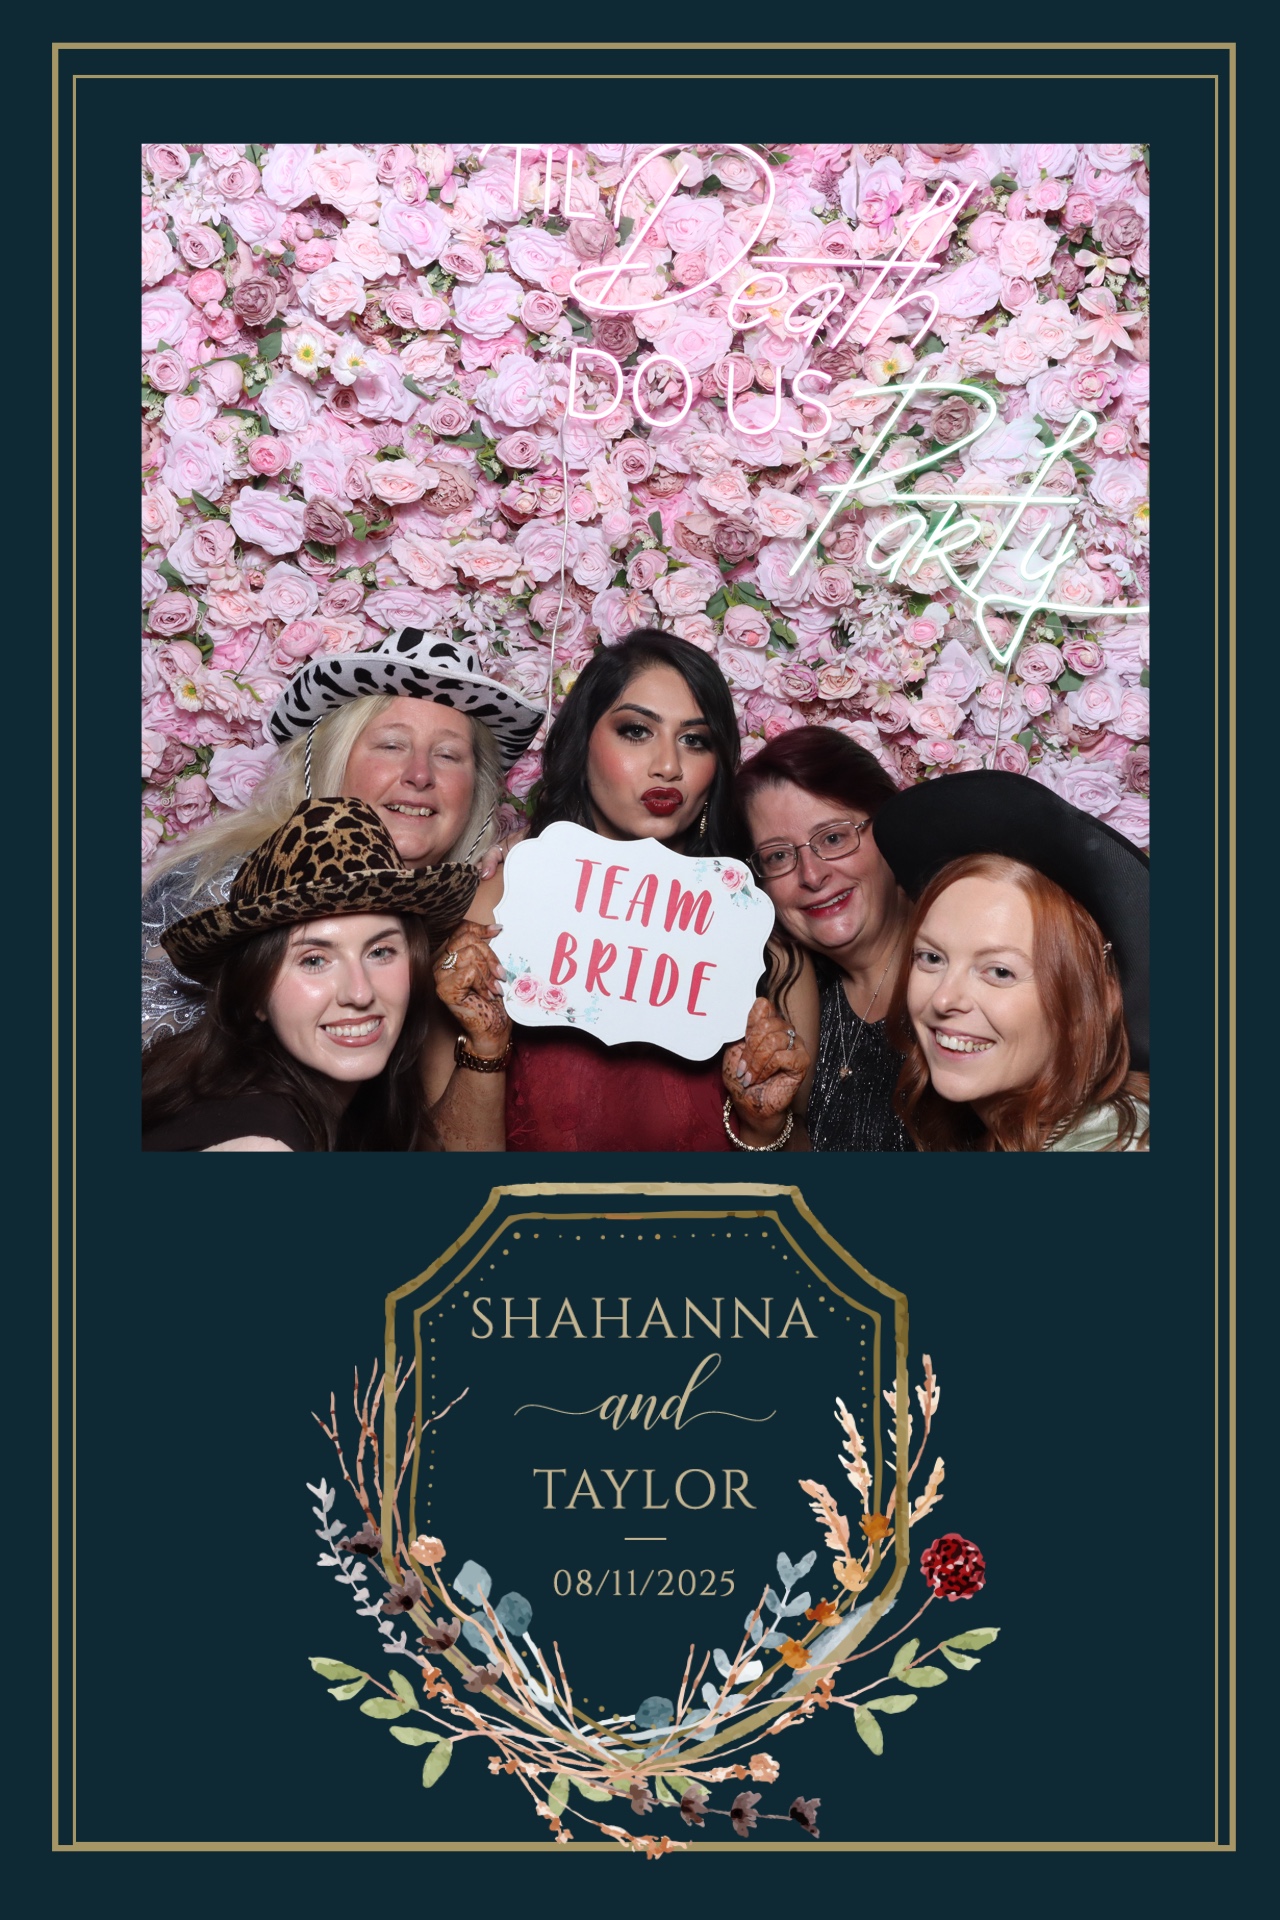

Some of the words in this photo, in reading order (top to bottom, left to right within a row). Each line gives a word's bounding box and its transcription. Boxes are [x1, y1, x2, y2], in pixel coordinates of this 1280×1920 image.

[569, 143, 977, 350] Death
[567, 347, 693, 428] DO
[727, 363, 834, 439] US
[574, 858, 715, 936] TEAM
[549, 931, 717, 1017] BRIDE
